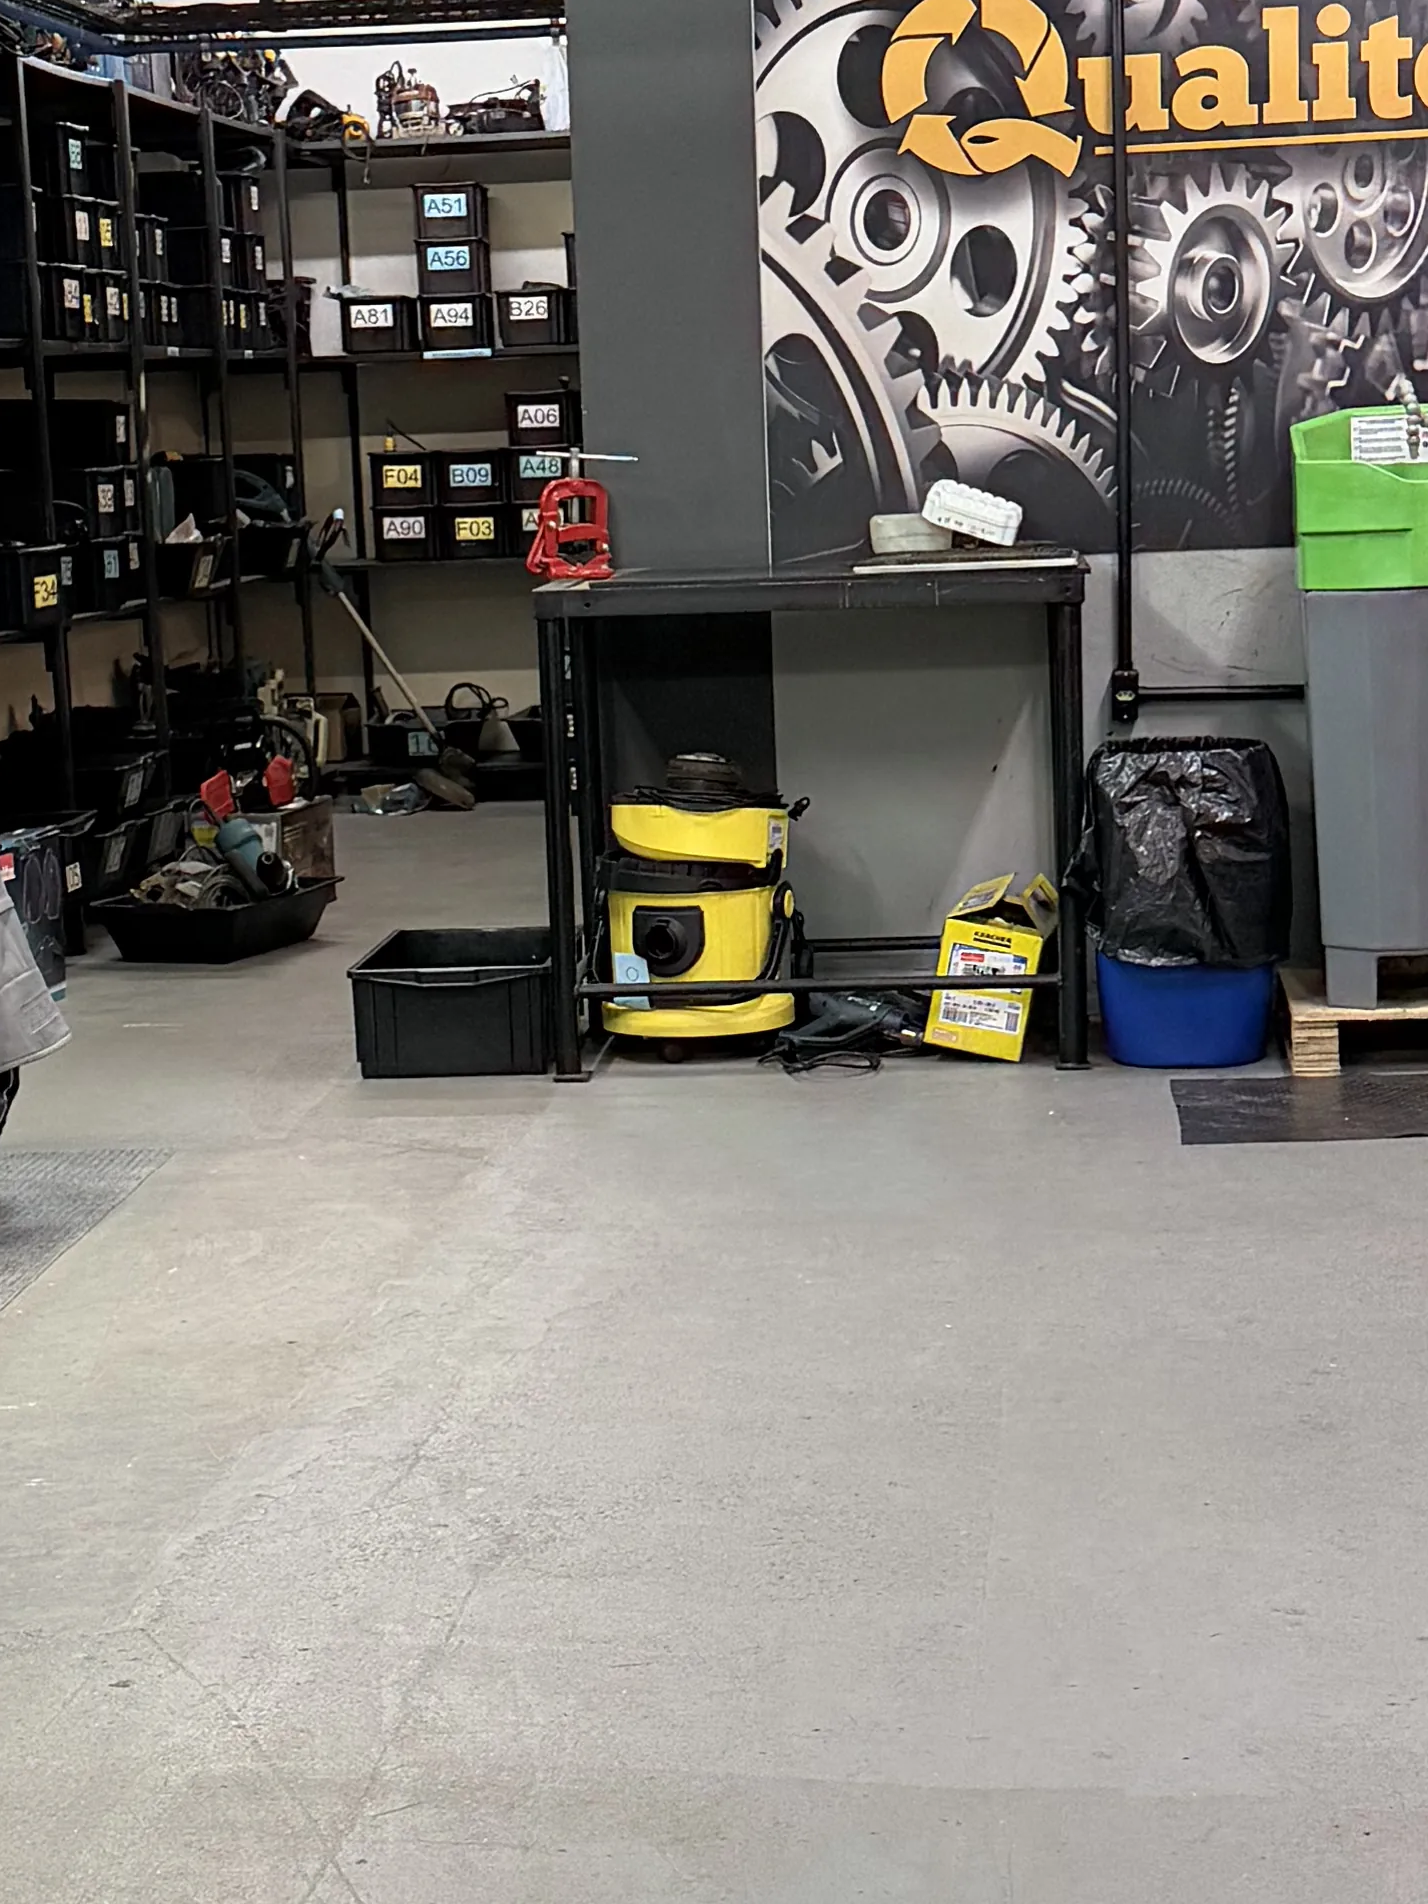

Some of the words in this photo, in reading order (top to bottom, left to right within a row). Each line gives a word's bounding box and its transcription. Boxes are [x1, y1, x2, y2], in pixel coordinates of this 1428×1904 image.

[427, 197, 463, 215] A51
[430, 250, 468, 267] A56
[353, 308, 389, 325] A81
[433, 307, 472, 324] A94
[519, 408, 558, 425] A06
[522, 457, 560, 475] A48
[384, 468, 420, 486] F04
[451, 467, 490, 484] B09
[385, 520, 424, 537] A90
[456, 521, 493, 537] F03
